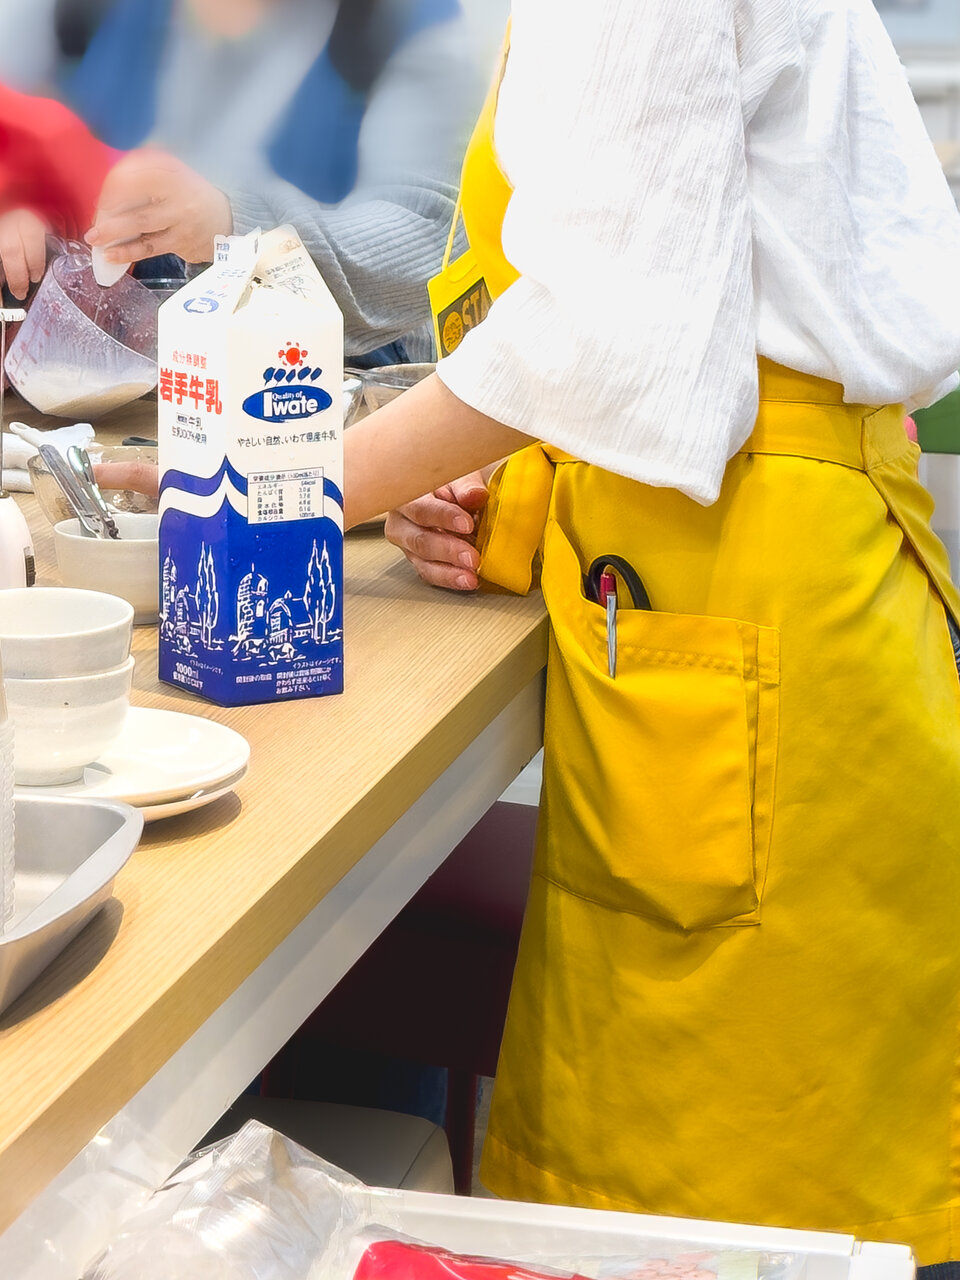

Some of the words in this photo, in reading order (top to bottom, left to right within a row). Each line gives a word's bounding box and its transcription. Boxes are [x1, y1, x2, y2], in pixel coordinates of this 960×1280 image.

[160, 368, 222, 415] 岩手牛乳
[263, 392, 318, 417] Iwate
